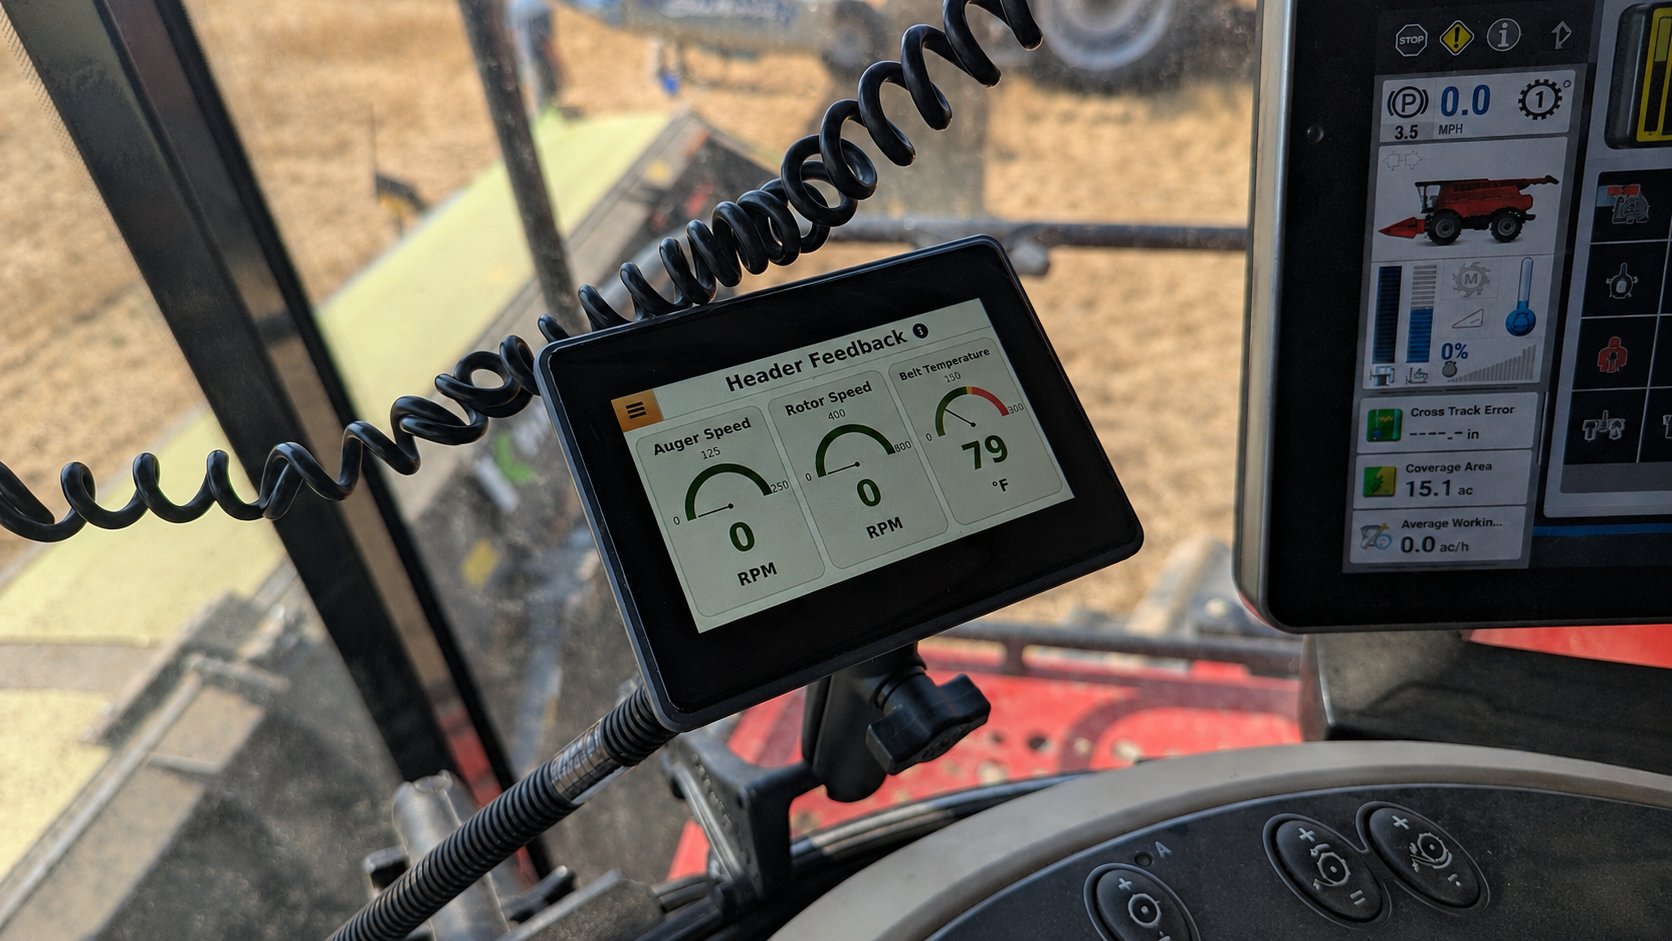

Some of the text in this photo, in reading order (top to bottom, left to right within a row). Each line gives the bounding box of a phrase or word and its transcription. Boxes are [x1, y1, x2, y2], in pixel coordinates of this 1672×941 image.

[1399, 35, 1424, 45] STOP
[1441, 84, 1490, 116] 0.0
[1395, 125, 1418, 140] 3.5
[1439, 124, 1463, 134] MPH
[1441, 342, 1468, 361] 0%
[726, 330, 907, 391] Header Feedback
[899, 347, 990, 382] Belt Temperature
[944, 371, 961, 383] 150
[785, 381, 872, 416] Rotor Speed
[828, 408, 846, 421] 400
[1008, 401, 1024, 414] 300
[1411, 404, 1515, 417] Cross Track Error
[653, 418, 752, 455] Auger Speed
[926, 433, 932, 441] 0
[1468, 429, 1479, 440] in
[701, 446, 720, 461] 125
[894, 440, 911, 453] 800
[962, 434, 1008, 470] 79
[1406, 461, 1492, 474] Coverage Area
[806, 473, 812, 481] 0
[771, 480, 789, 493] 250
[856, 478, 881, 507] 0
[991, 478, 1010, 493] °F
[1406, 480, 1473, 497] 15.1 ac
[673, 516, 680, 525] 0
[866, 516, 903, 539] RPM
[1401, 517, 1503, 530] Average Workin...
[729, 521, 755, 552] 0
[1401, 536, 1469, 553] 0.0 ac/h
[737, 562, 777, 586] RPM
